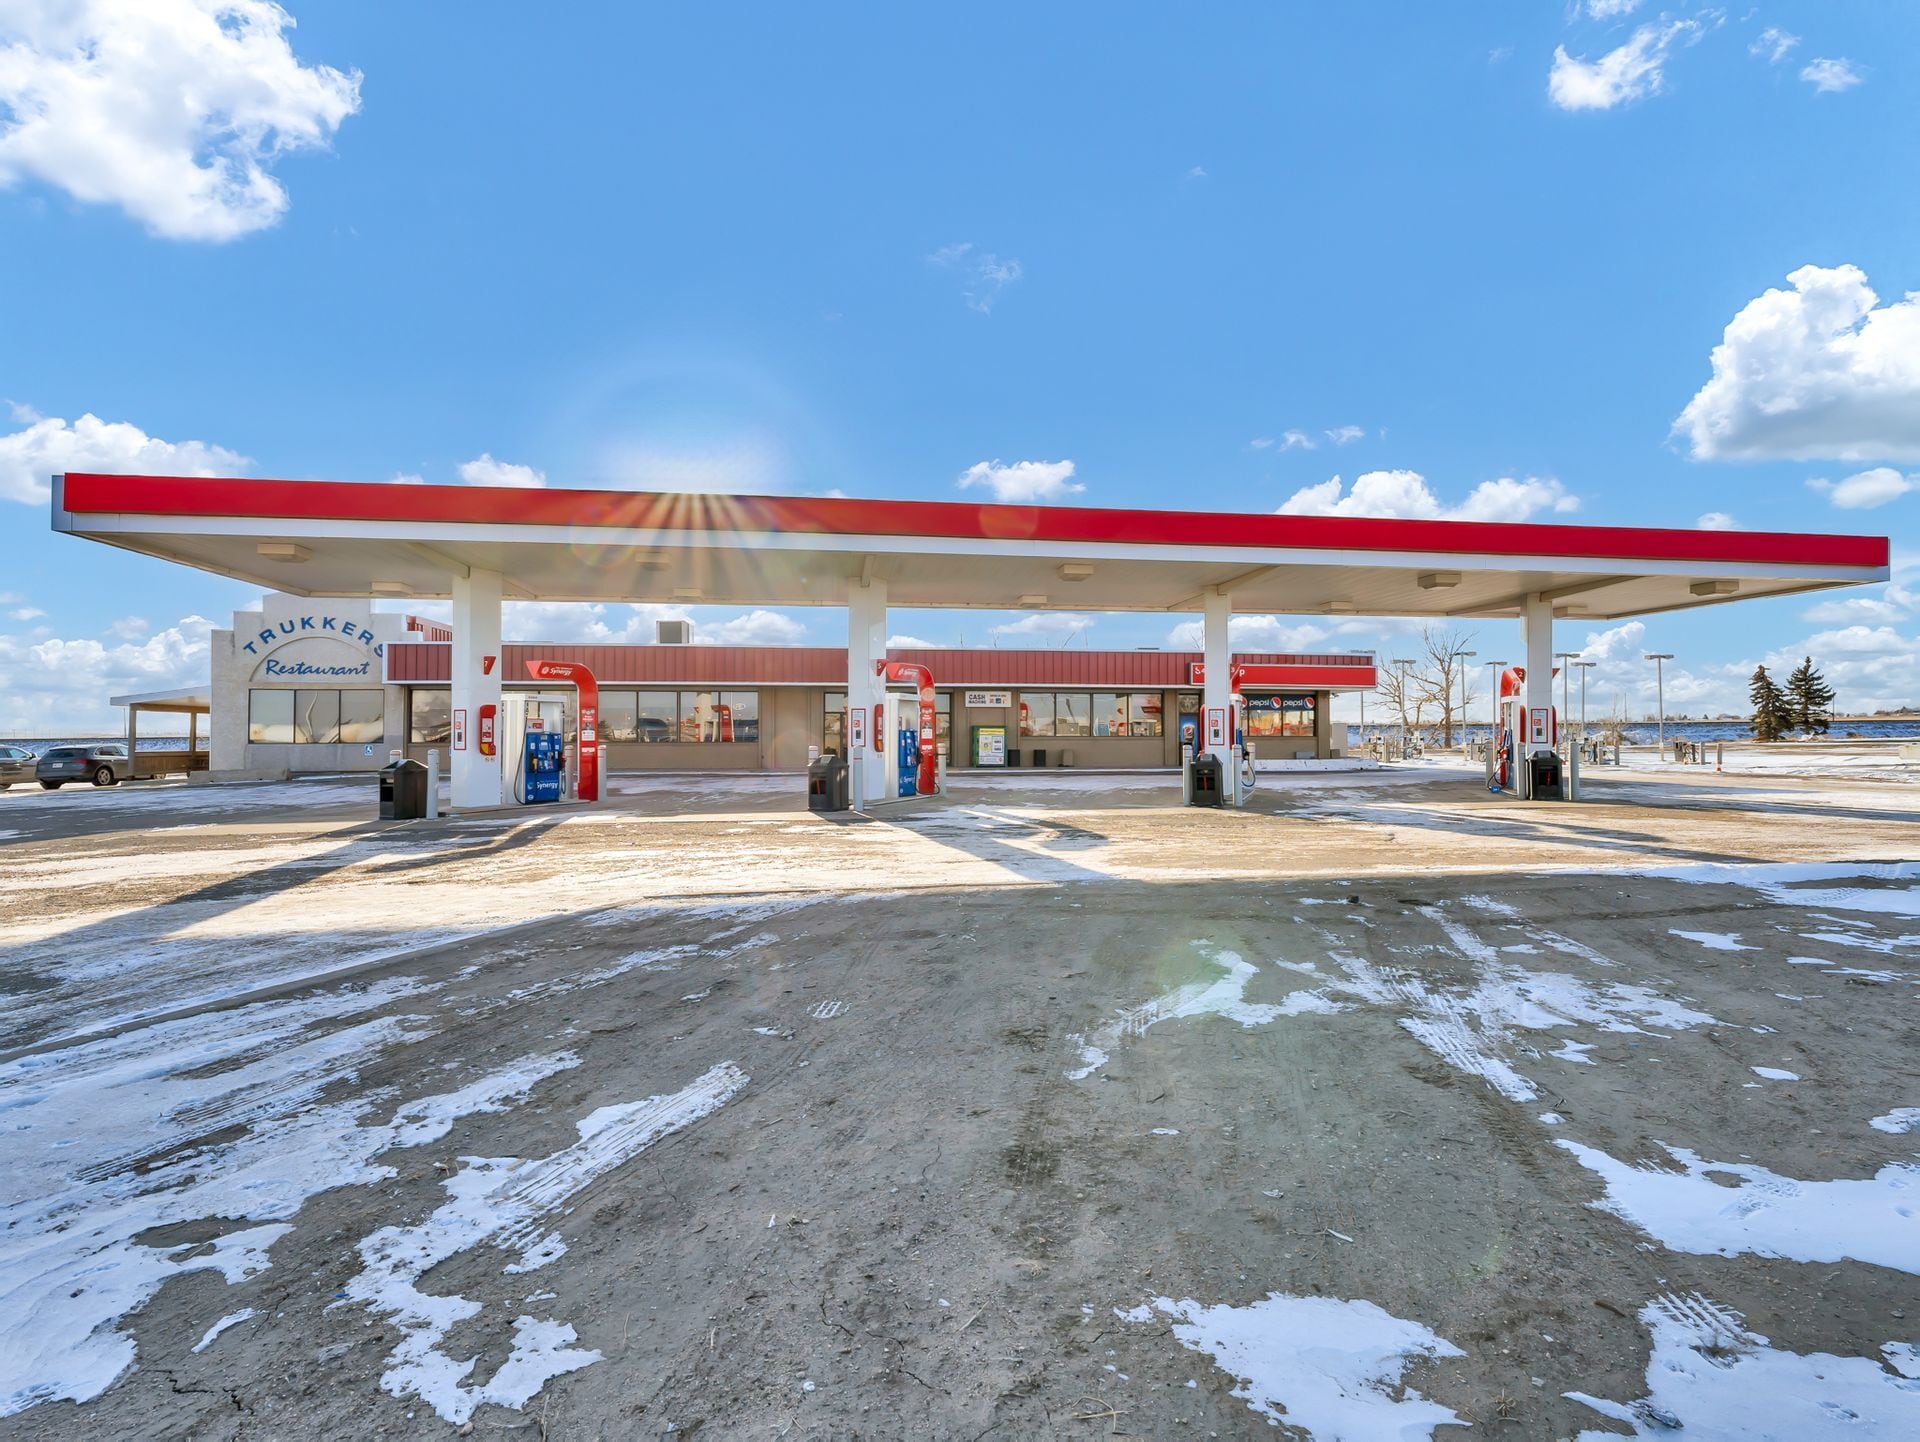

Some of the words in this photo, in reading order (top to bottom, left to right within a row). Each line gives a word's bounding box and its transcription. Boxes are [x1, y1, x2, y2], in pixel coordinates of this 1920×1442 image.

[266, 659, 370, 676] Restaurant
[550, 667, 572, 676] Synergy
[537, 782, 558, 790] Synergy
